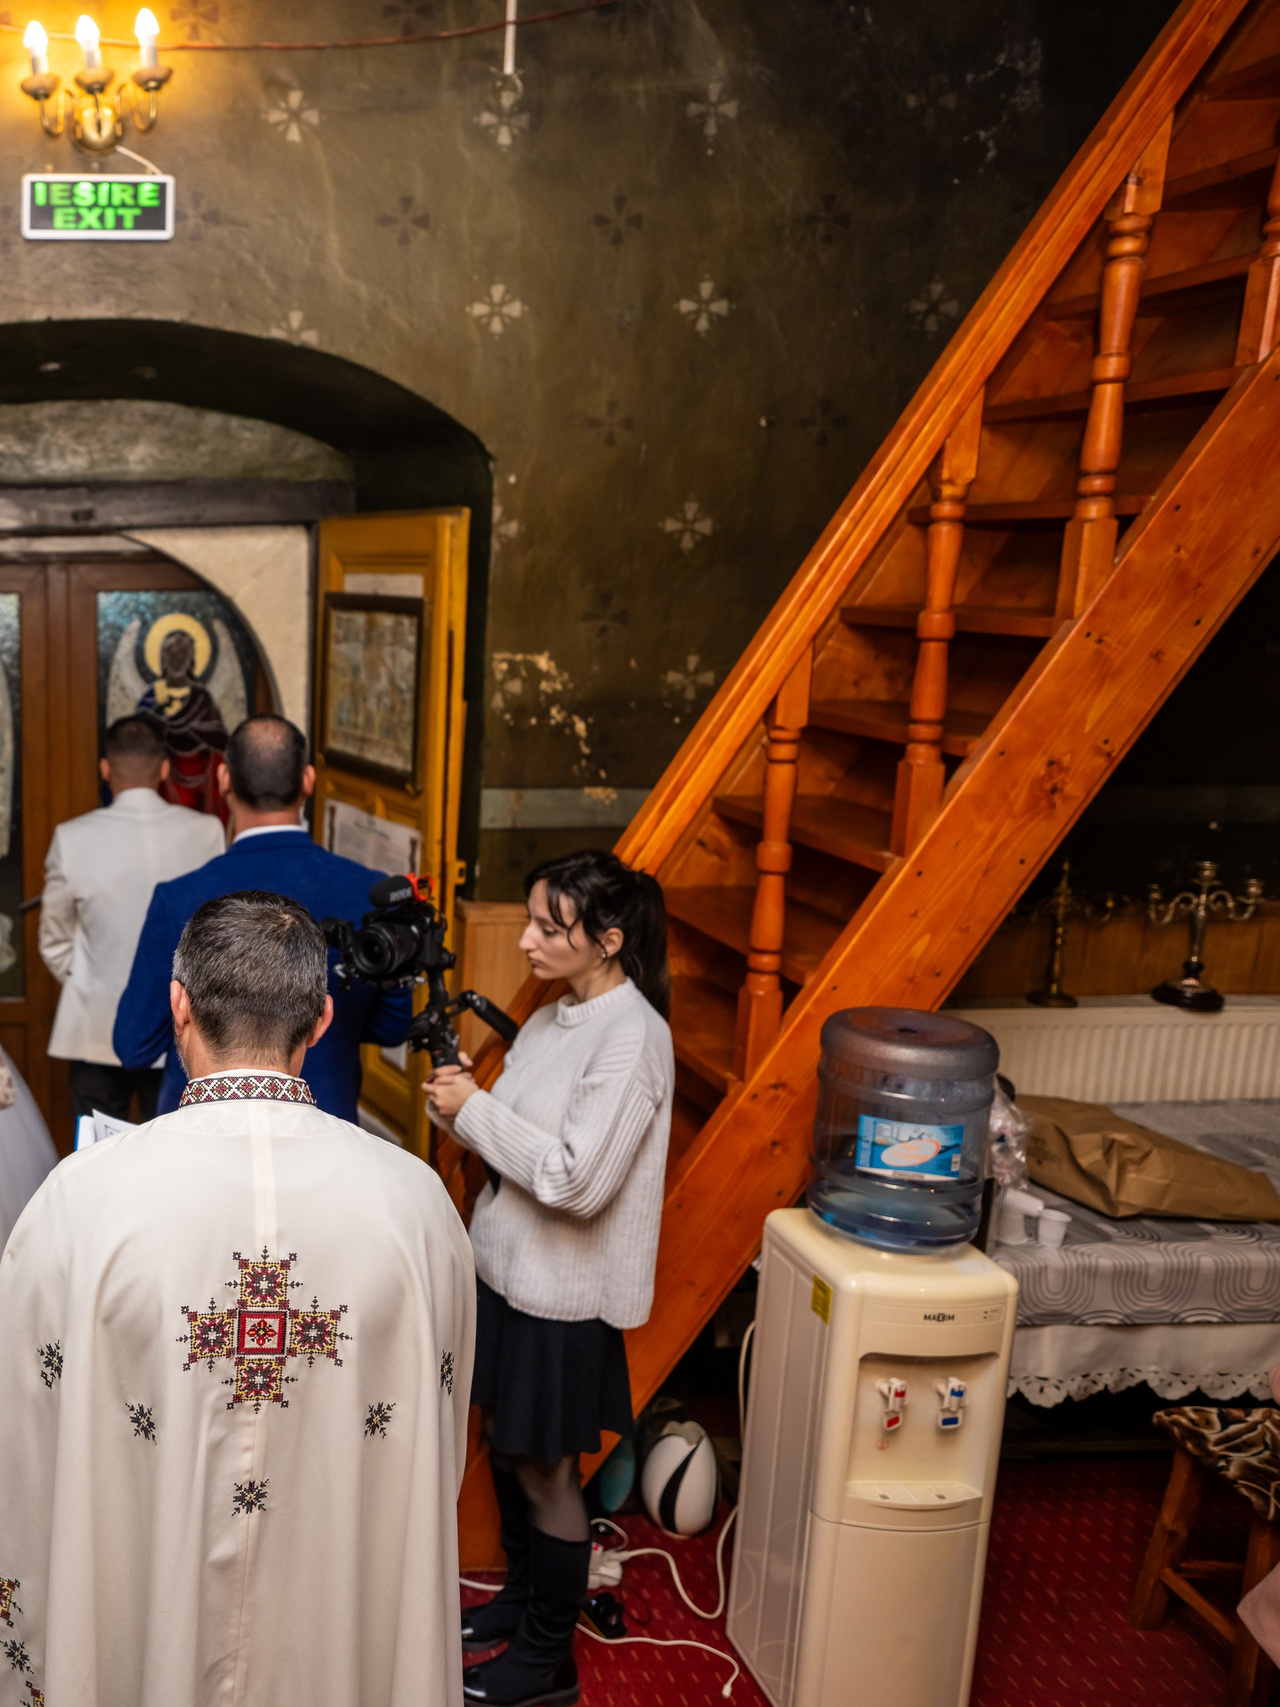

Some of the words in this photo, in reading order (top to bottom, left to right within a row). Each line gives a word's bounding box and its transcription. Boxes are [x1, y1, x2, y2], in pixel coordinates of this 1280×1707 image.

[34, 181, 161, 207] IESIRE
[53, 207, 142, 230] EXIT
[923, 1313, 956, 1323] MAXIM
